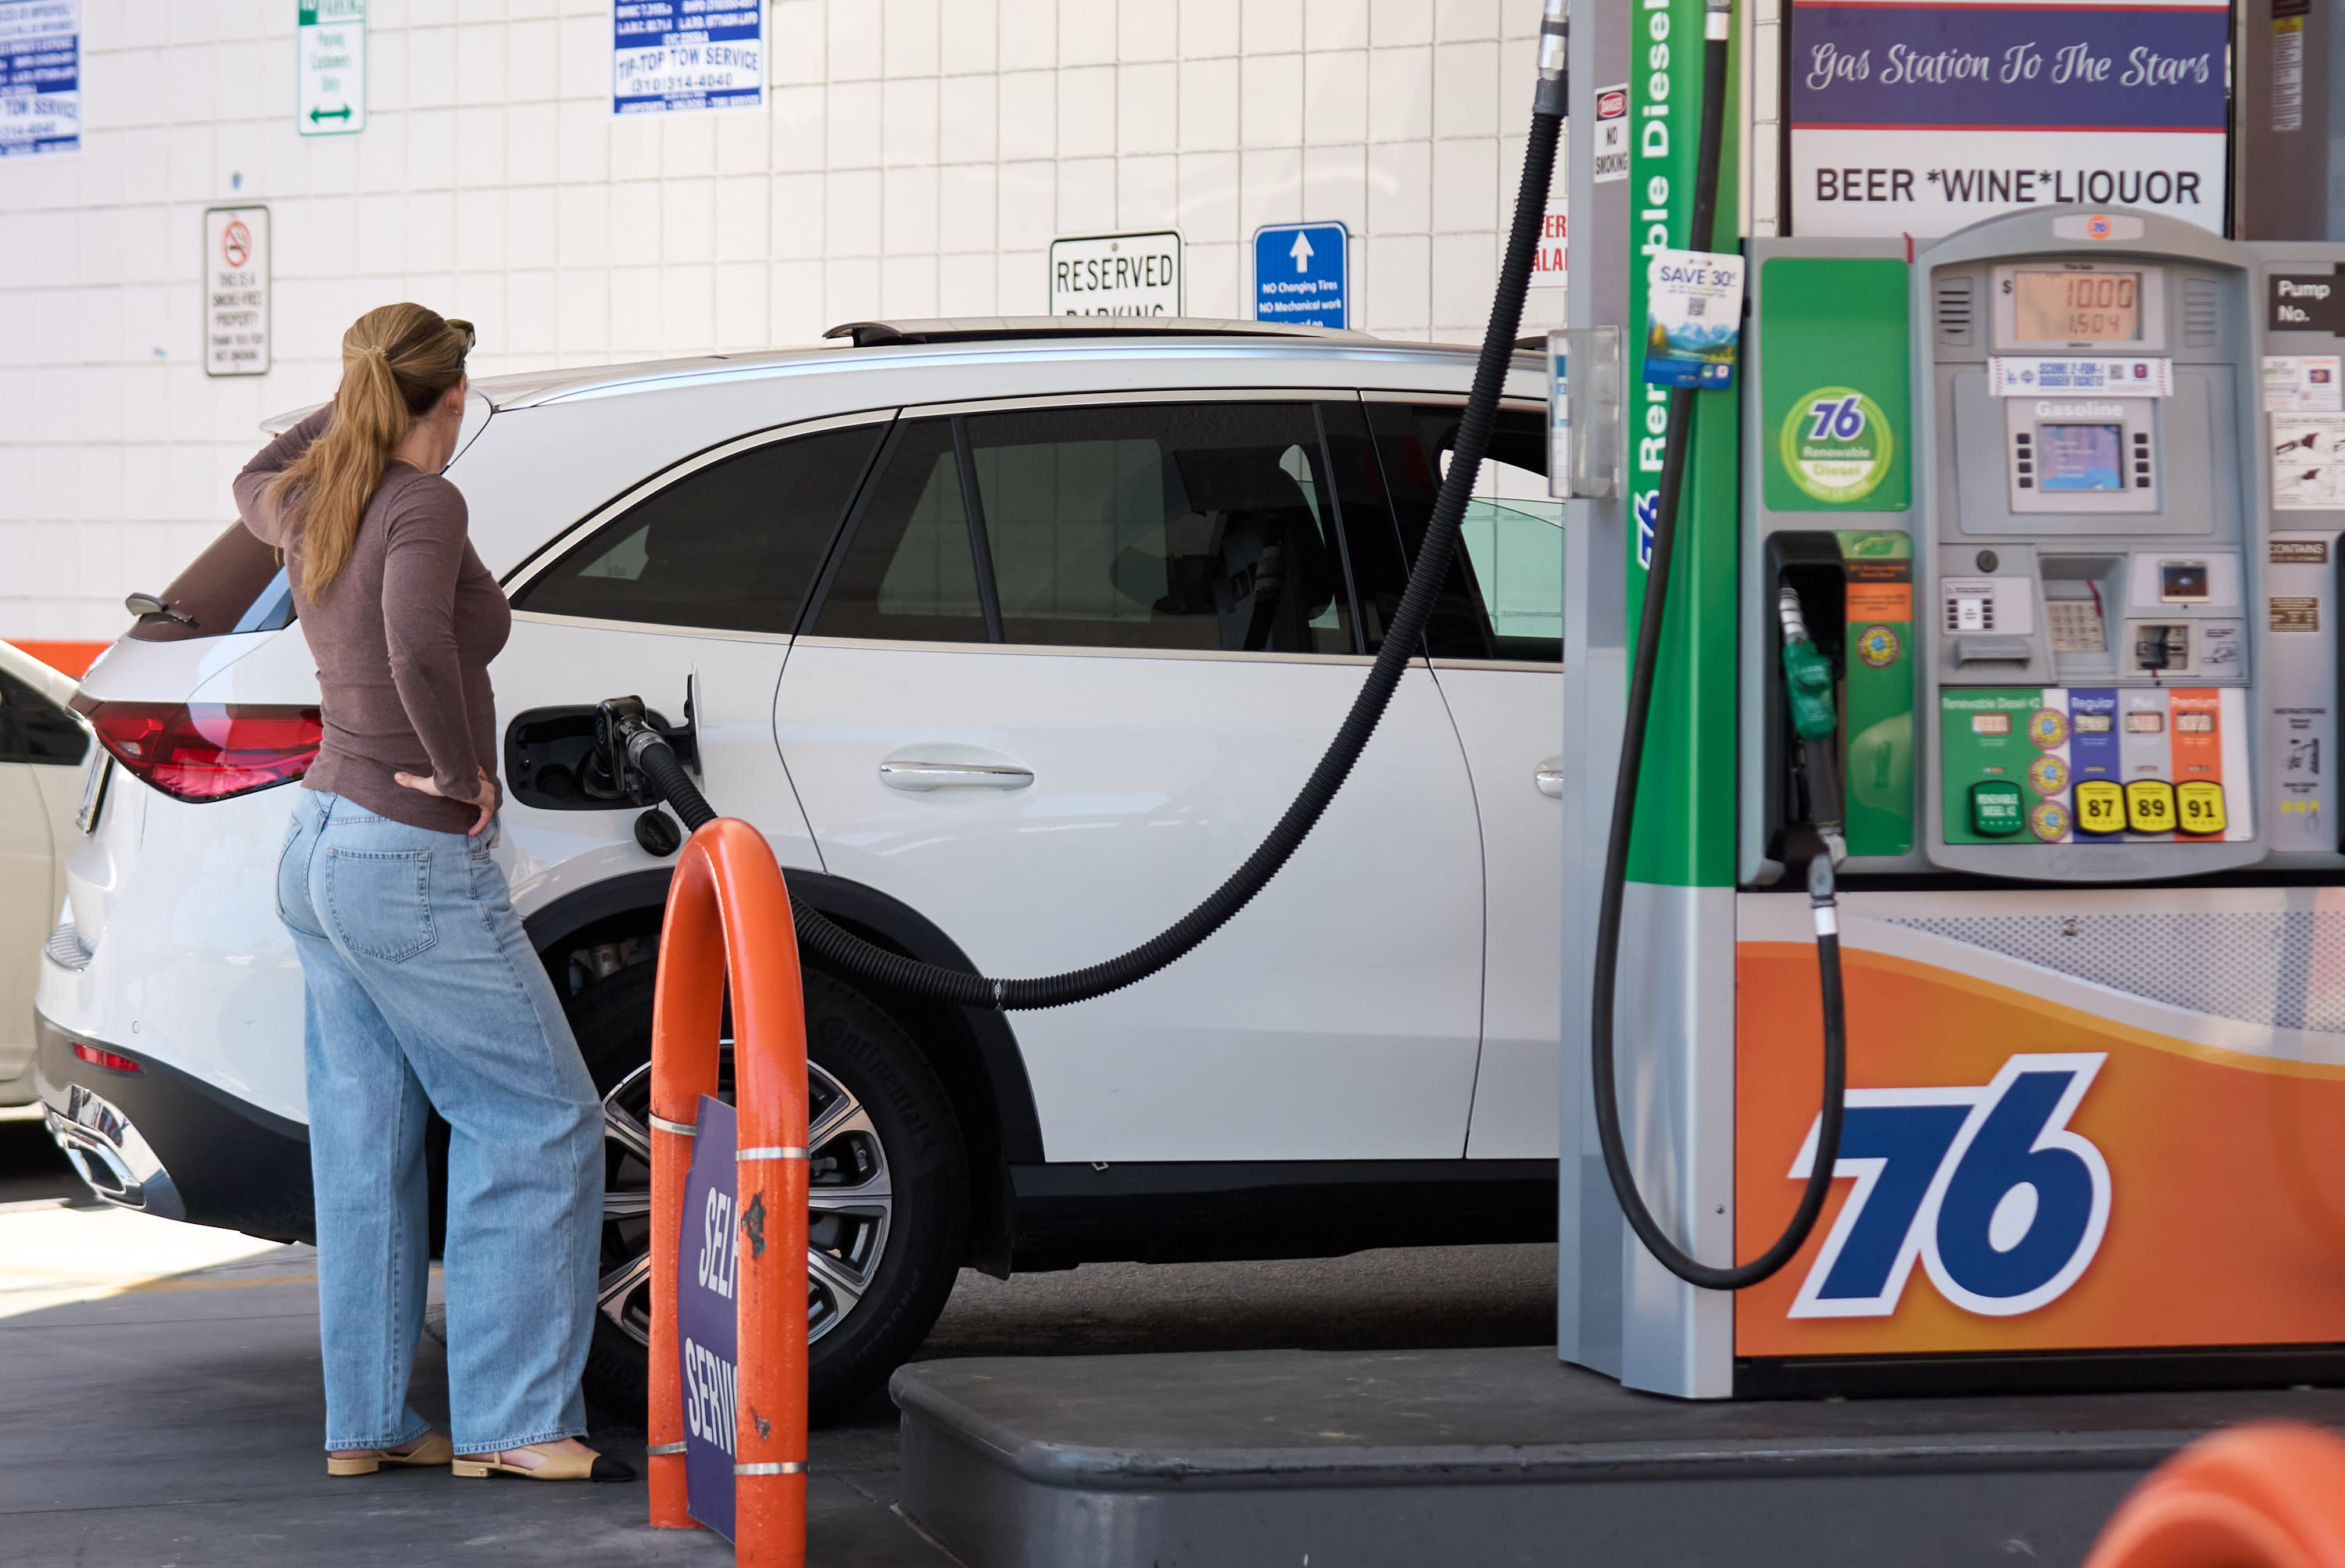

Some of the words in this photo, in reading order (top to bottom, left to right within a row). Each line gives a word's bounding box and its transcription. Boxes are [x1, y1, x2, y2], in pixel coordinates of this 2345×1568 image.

[620, 51, 664, 79] TIP-TOP
[671, 48, 700, 66] TOW
[707, 47, 757, 71] SERVICE
[1806, 42, 1871, 90] Gas
[1880, 43, 1990, 84] Station
[2001, 42, 2043, 84] To
[2051, 42, 2111, 84] The
[2120, 45, 2210, 87] Stars
[1642, 0, 1670, 156] Diesel
[1607, 125, 1618, 146] NO
[1596, 152, 1627, 175] SMOKING
[1816, 168, 1915, 202] BEER
[1538, 214, 1567, 238] ER
[1058, 255, 1172, 293] RESERVED
[1660, 266, 1707, 285] SAVE
[1262, 282, 1277, 294] NO
[1278, 281, 1317, 294] Changing
[1318, 280, 1338, 291] Tires
[2003, 280, 2013, 295] $
[2278, 280, 2331, 299] Pump
[1259, 302, 1273, 313] NO
[1275, 299, 1320, 313] Mechanical
[1322, 298, 1342, 310] work
[2278, 306, 2311, 322] No.
[1807, 394, 1866, 441] 76
[2035, 400, 2125, 417] Gasoline
[1803, 446, 1871, 459] Renewable
[1813, 462, 1861, 476] Diesel
[2072, 696, 2114, 711] Regular
[2168, 696, 2221, 708] Premium
[2088, 799, 2114, 817] 87
[2138, 799, 2165, 817] 89
[2188, 800, 2214, 818] 91
[1786, 1051, 2112, 1319] 76
